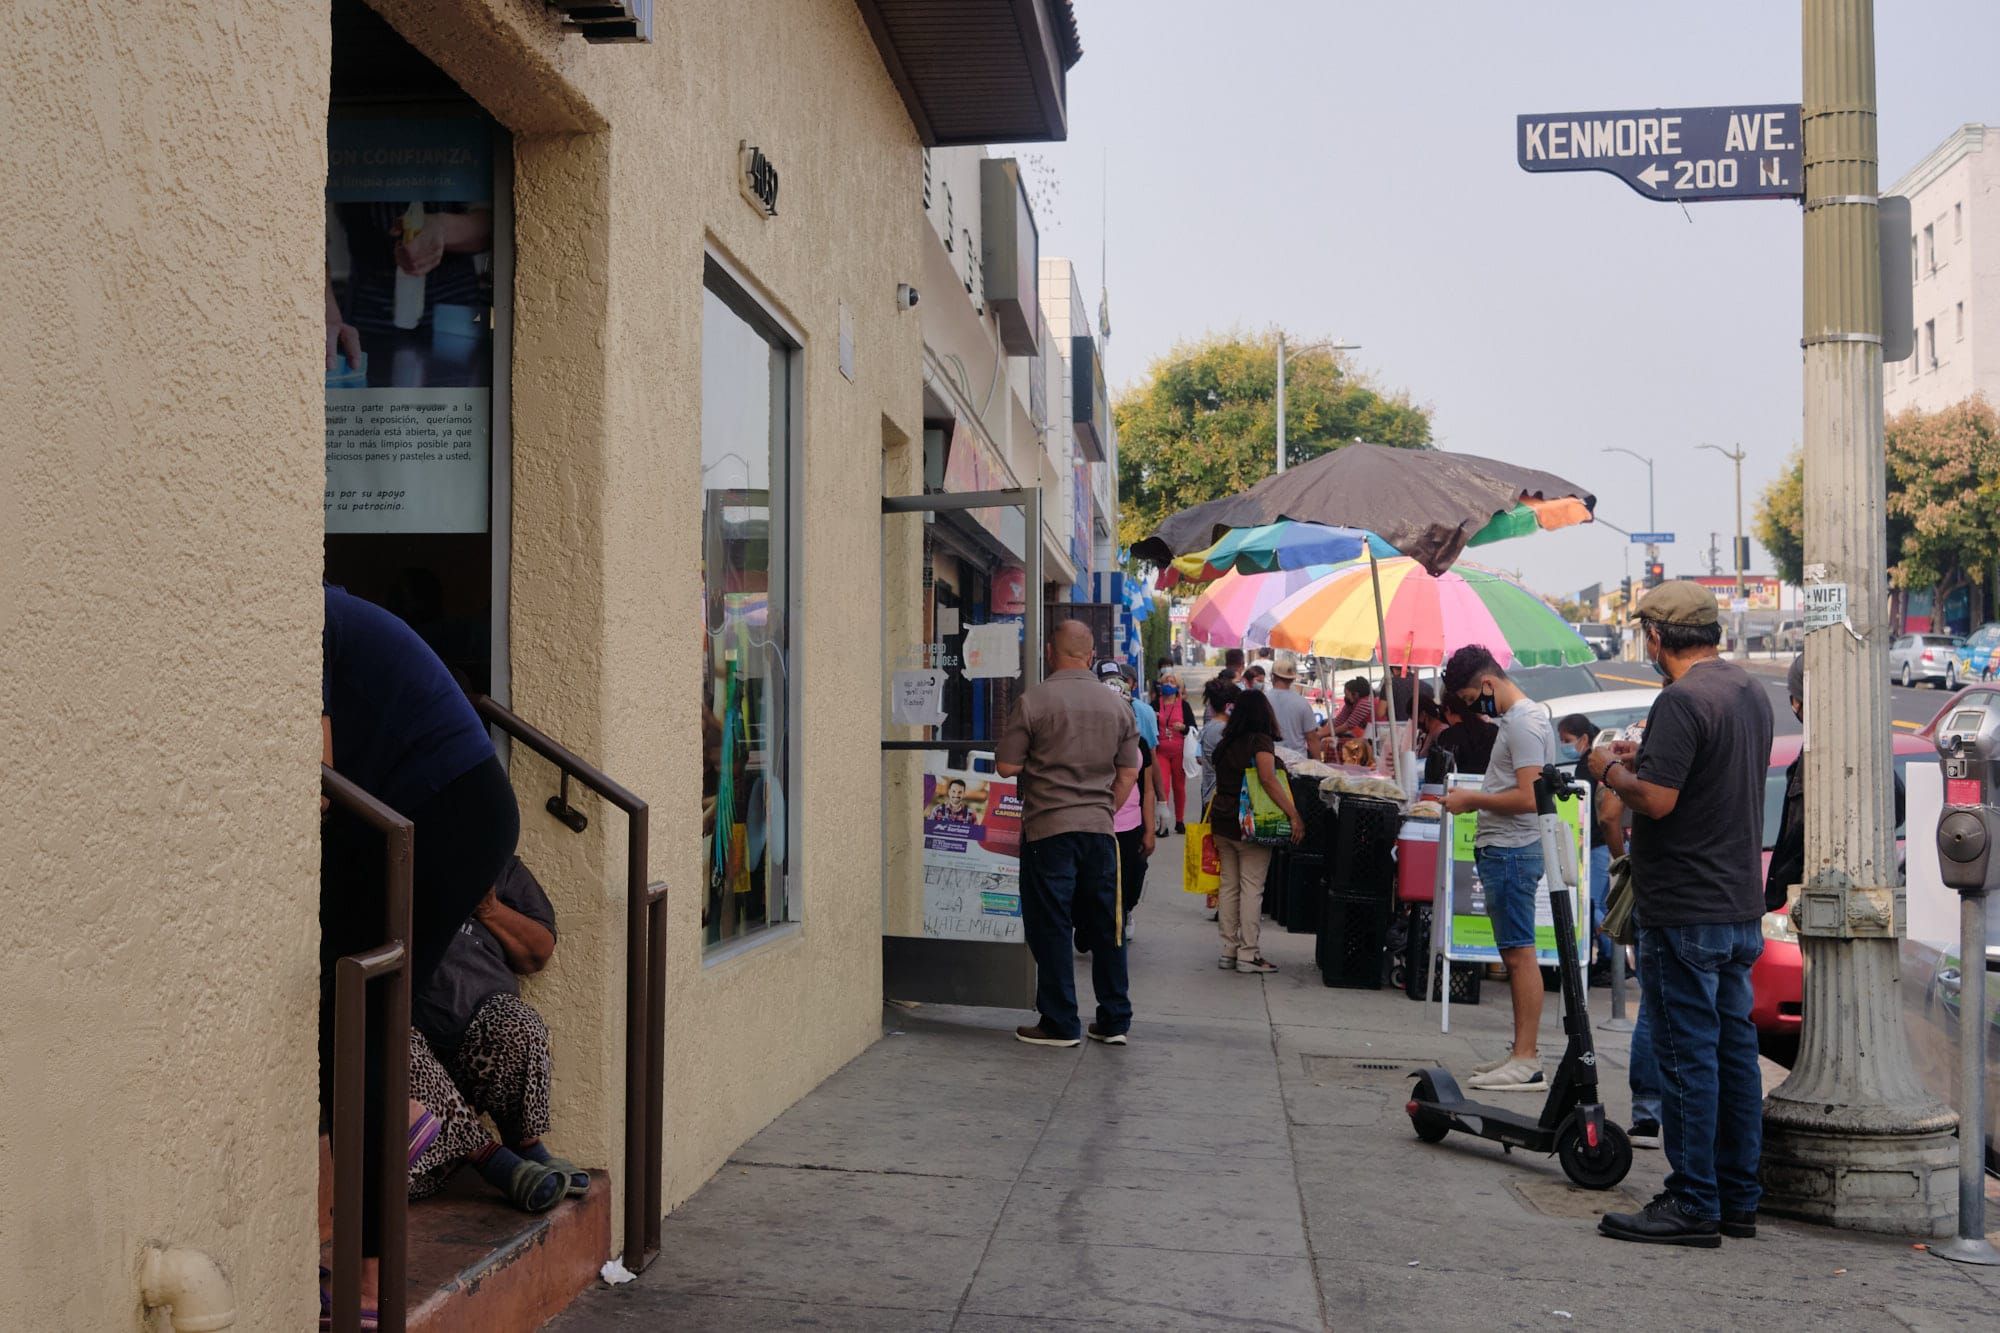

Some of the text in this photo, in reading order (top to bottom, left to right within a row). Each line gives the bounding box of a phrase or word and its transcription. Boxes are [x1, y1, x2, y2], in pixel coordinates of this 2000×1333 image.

[1525, 112, 1795, 160] KENMORE AVE.
[1674, 157, 1789, 190] 200 N.
[362, 404, 383, 414] parte
[453, 404, 458, 412] a
[464, 402, 473, 412] la
[355, 415, 363, 424] la
[405, 427, 438, 438] abierta,
[442, 429, 452, 438] ya
[456, 429, 473, 439] que
[346, 439, 355, 449] lo
[381, 439, 413, 450] limpios
[417, 439, 449, 450] posible
[453, 441, 472, 451] para
[365, 453, 390, 463] panes
[392, 453, 398, 463] y
[400, 451, 436, 463] pasteles
[437, 453, 443, 461] a
[445, 451, 471, 462] usted,
[340, 490, 357, 500] por
[362, 490, 372, 498] su
[377, 490, 405, 500] apoyo
[337, 503, 348, 511] su
[1813, 588, 1841, 603] WIFI
